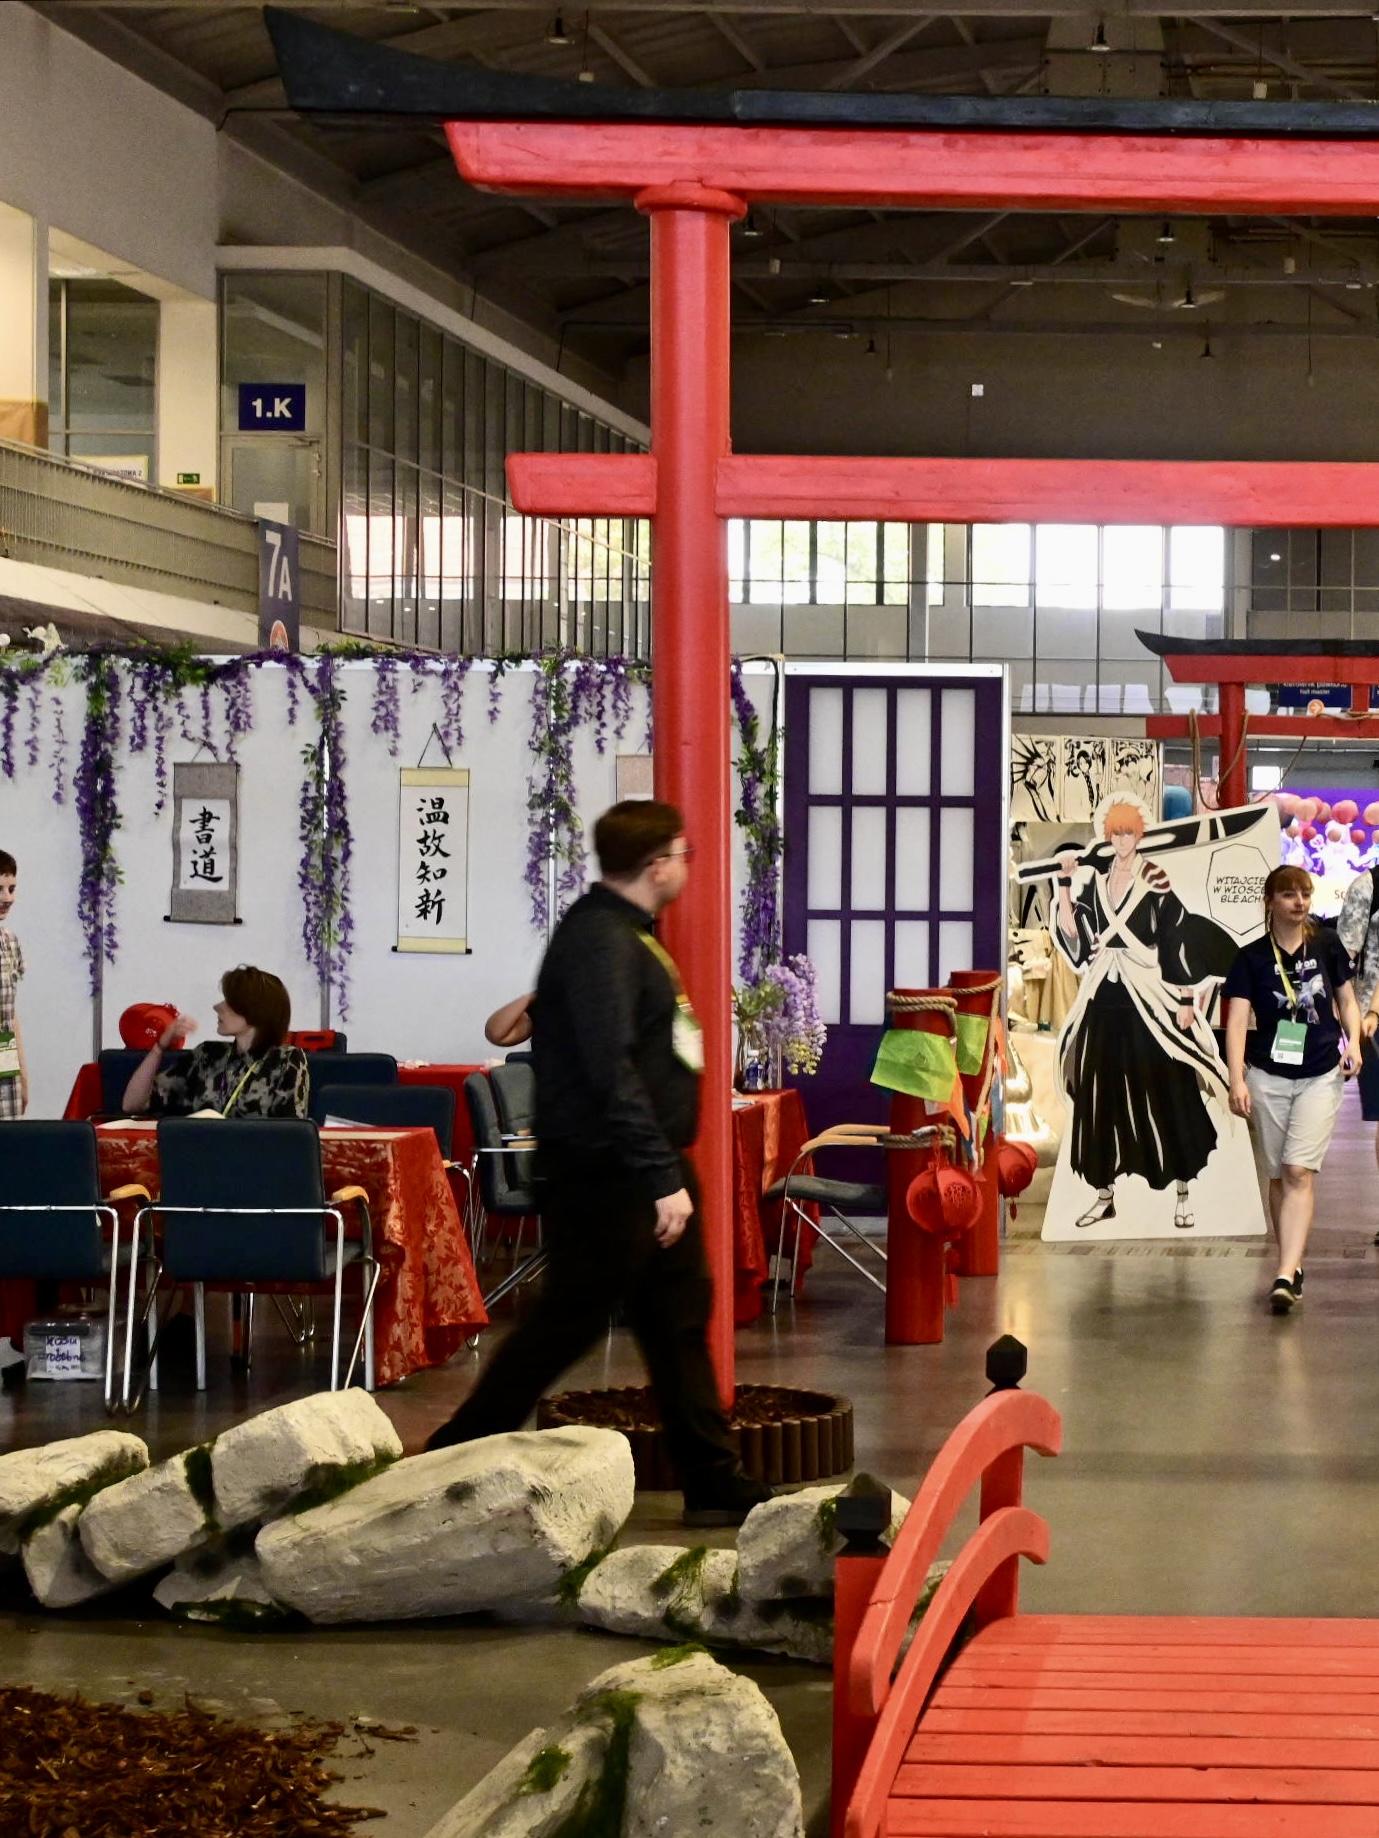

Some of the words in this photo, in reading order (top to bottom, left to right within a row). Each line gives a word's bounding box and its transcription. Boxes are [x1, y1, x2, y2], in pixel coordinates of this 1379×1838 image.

[252, 398, 292, 418] 1.K
[266, 530, 292, 601] 7A
[189, 805, 223, 883] 書道
[415, 797, 451, 925] 温故知新
[1213, 885, 1221, 894] W
[1224, 885, 1265, 895] WIOSCE
[1216, 876, 1266, 885] WITAJCIE
[1220, 894, 1261, 903] BLEACH
